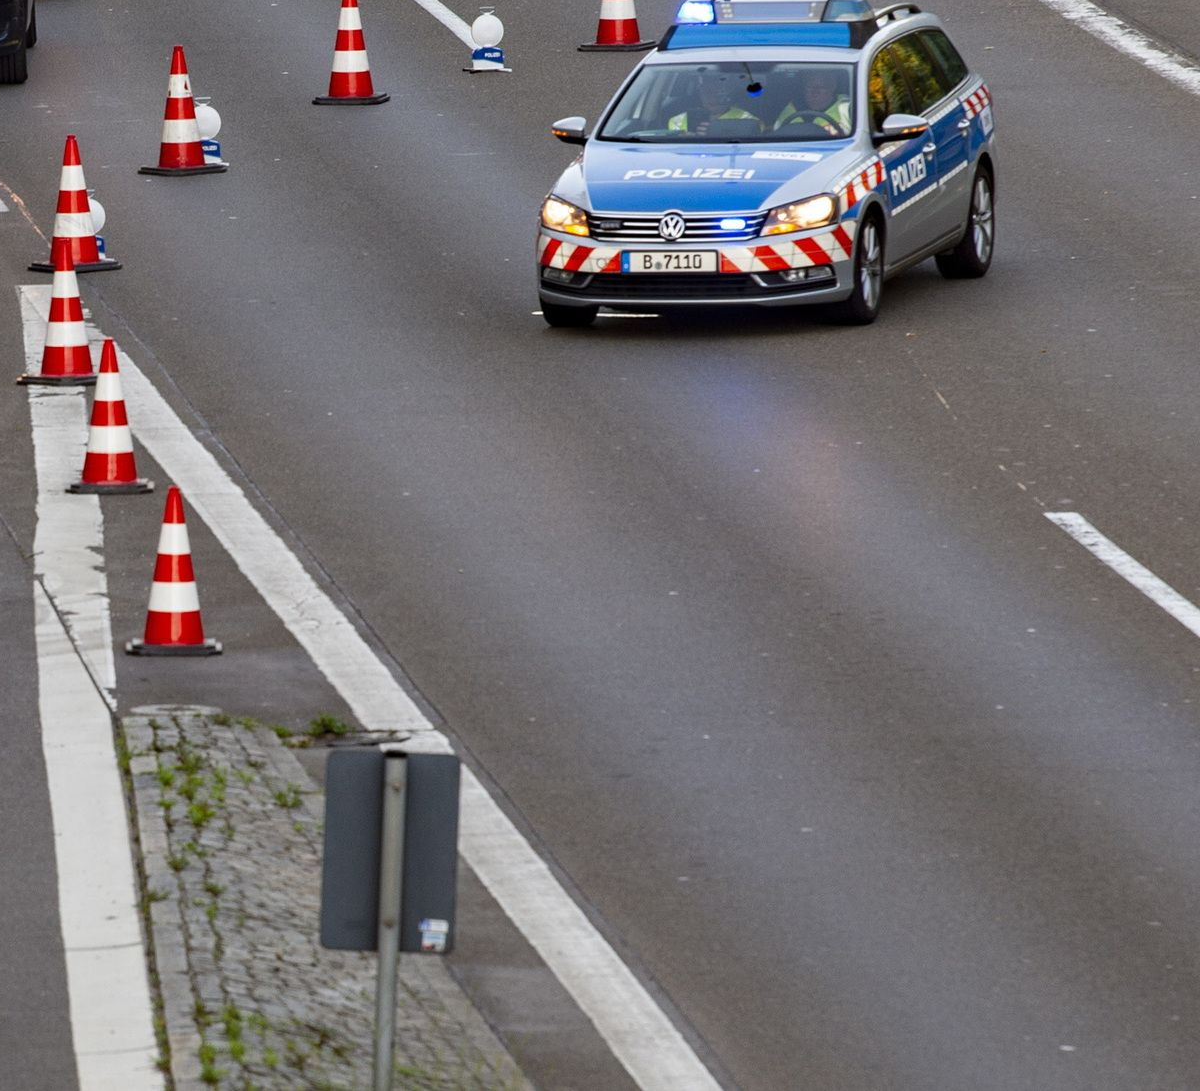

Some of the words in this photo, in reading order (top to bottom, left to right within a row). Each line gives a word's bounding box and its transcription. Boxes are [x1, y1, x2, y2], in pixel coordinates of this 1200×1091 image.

[623, 168, 756, 180] POLIZEI
[890, 152, 927, 197] POLIZEI
[643, 254, 653, 269] B
[664, 254, 702, 269] 7110
